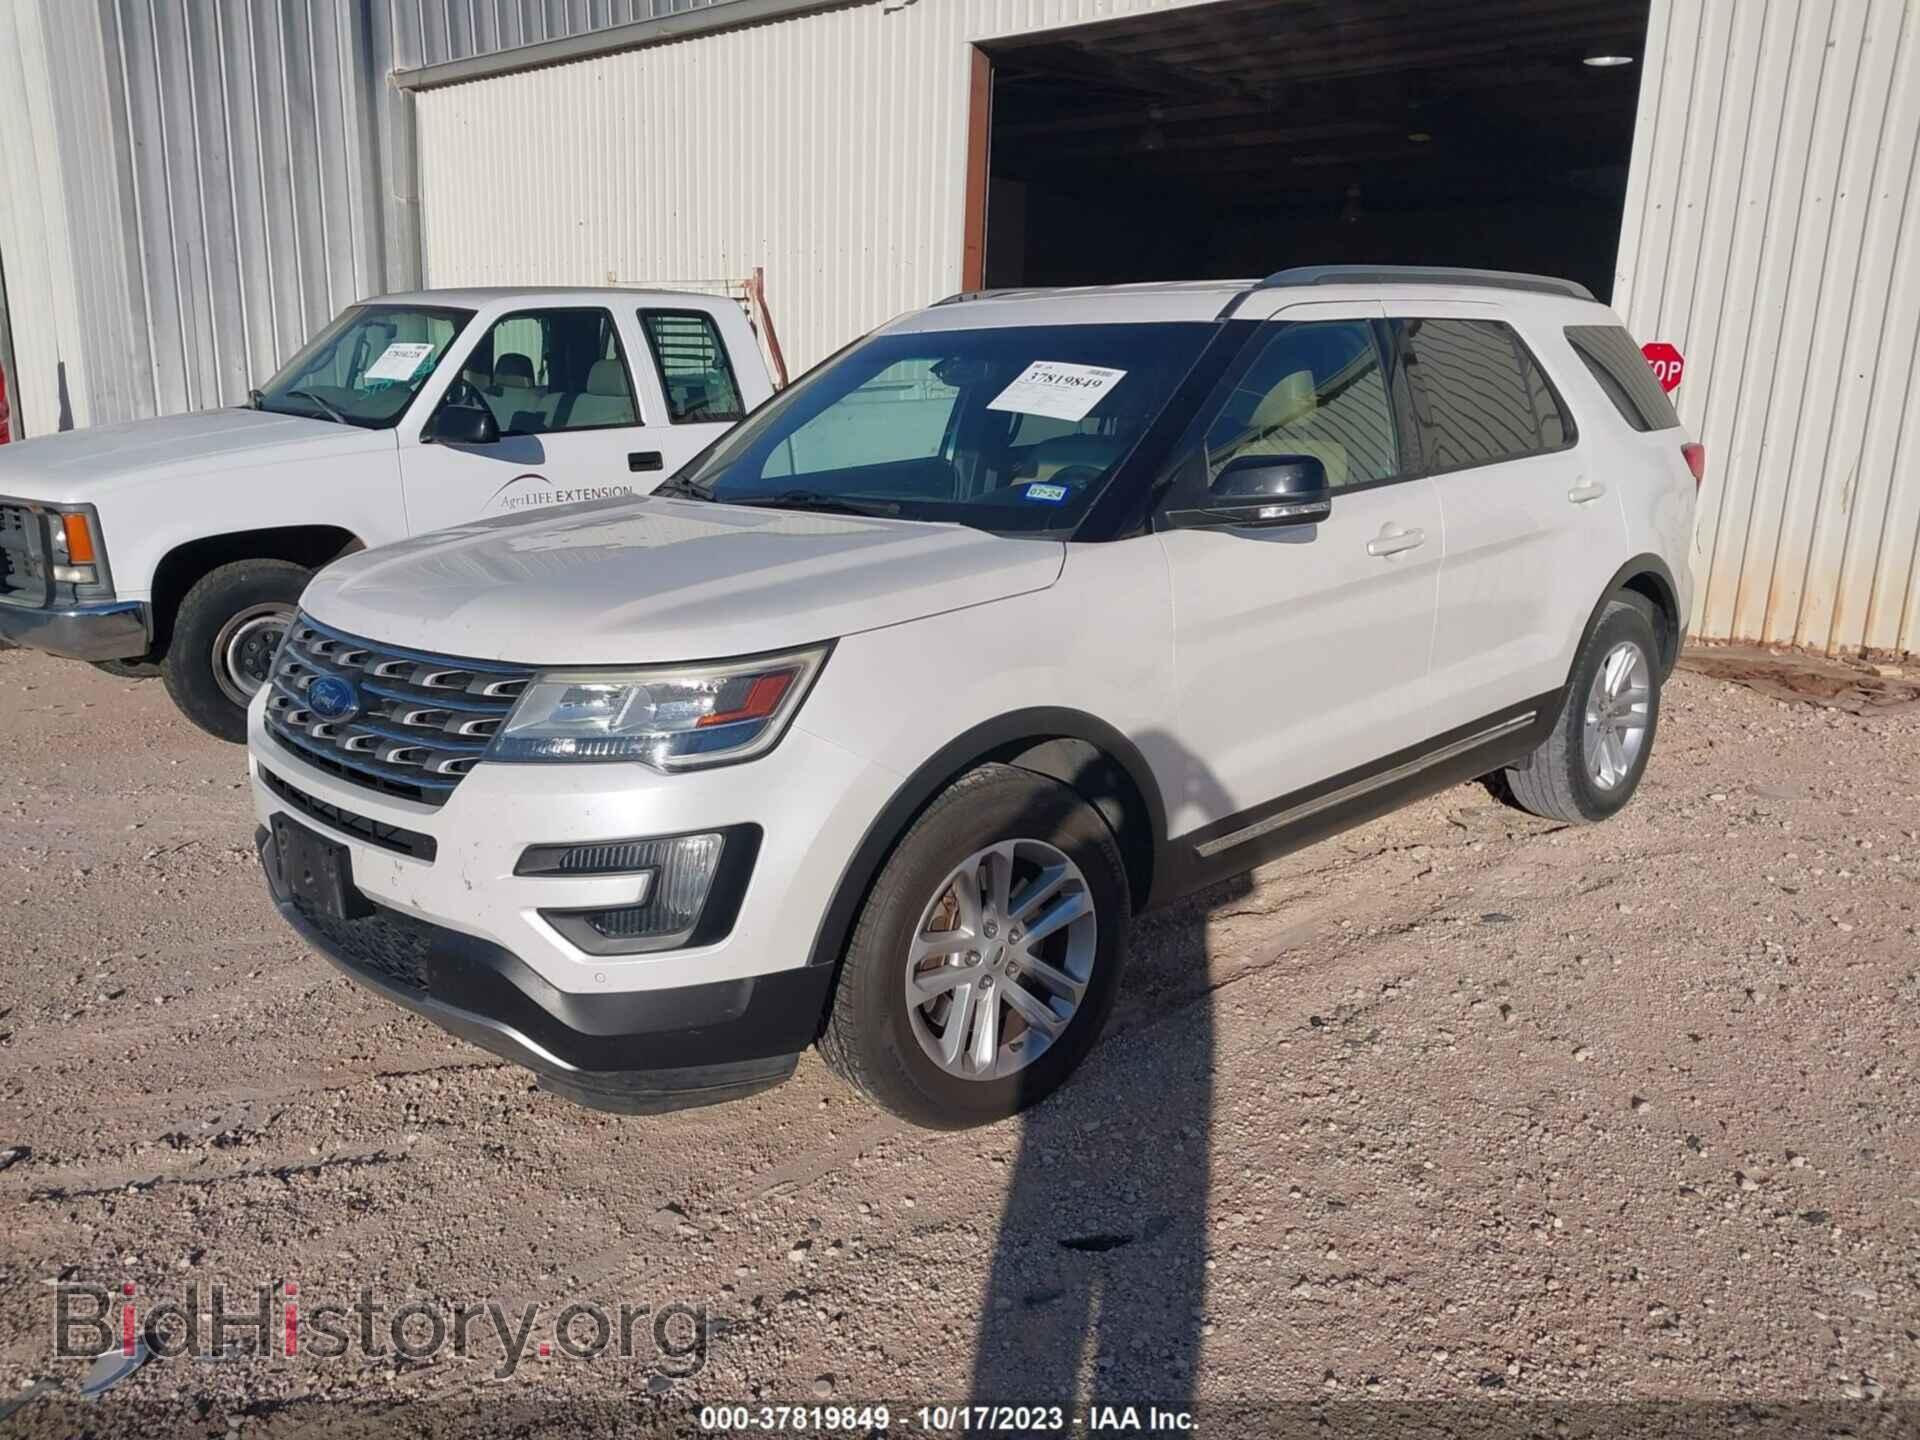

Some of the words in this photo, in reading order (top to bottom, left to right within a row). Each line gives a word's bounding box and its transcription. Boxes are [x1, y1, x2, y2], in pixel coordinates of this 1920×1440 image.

[1028, 370, 1103, 389] 37819849
[1648, 360, 1681, 382] OP
[500, 491, 554, 510] AgriLIFE
[556, 486, 633, 503] EXTENSION
